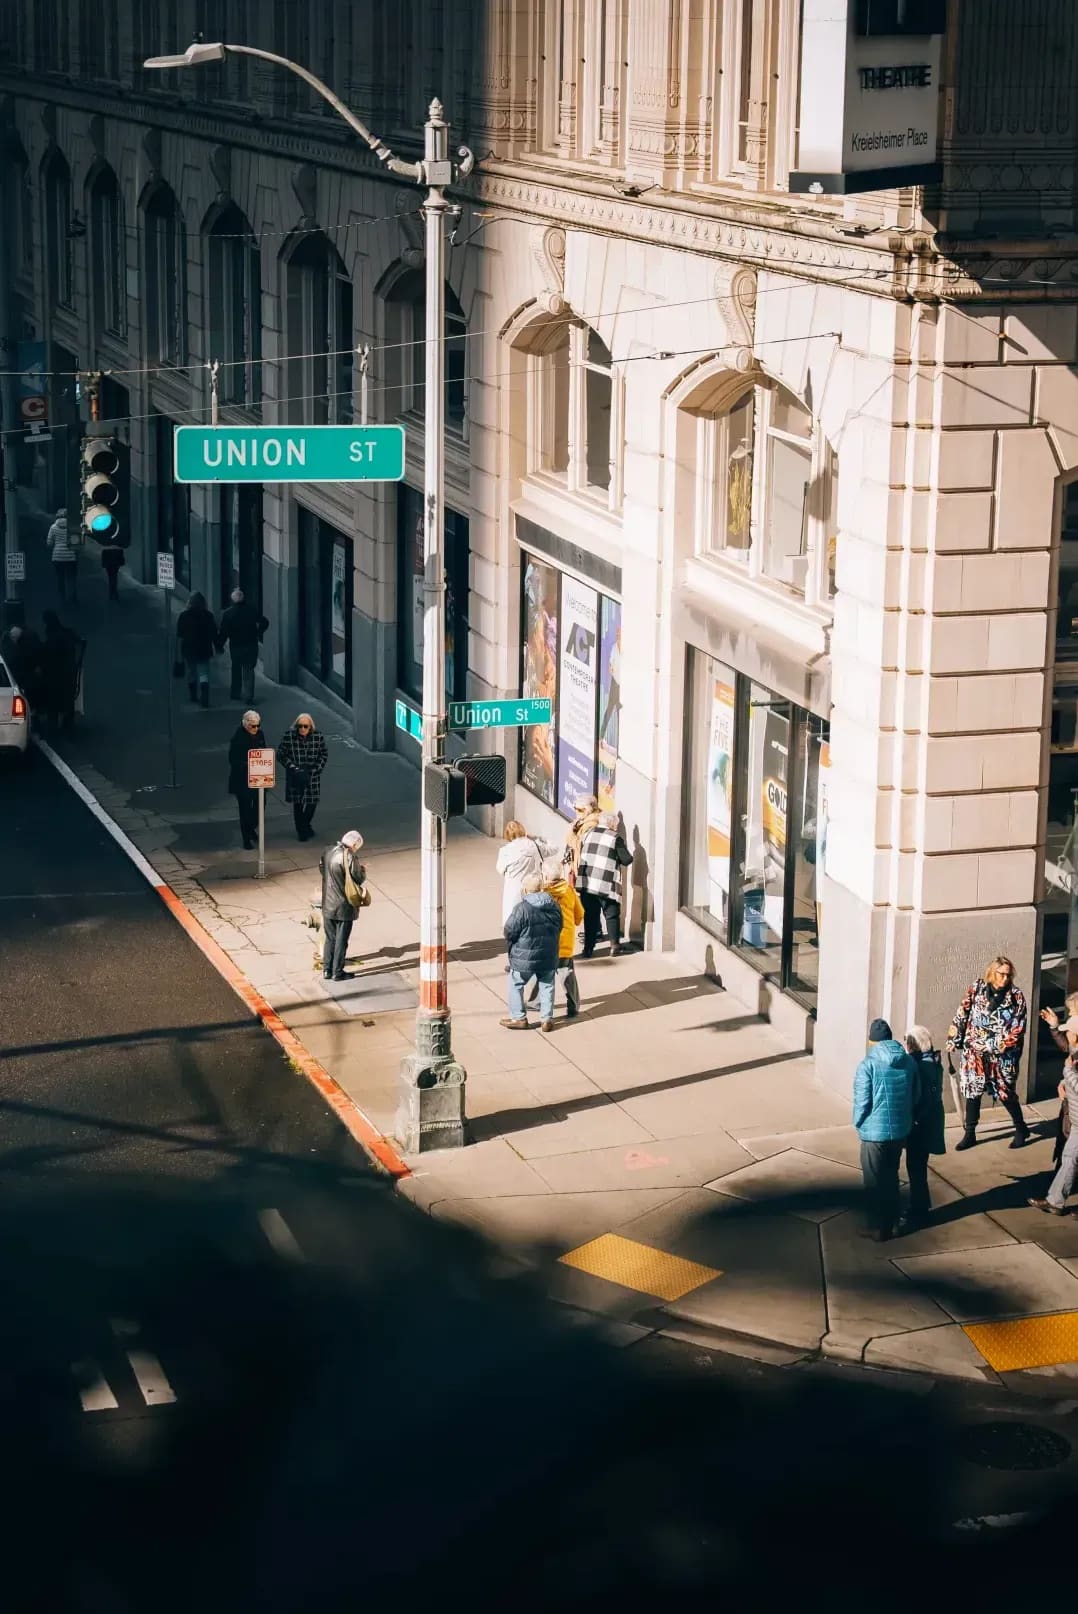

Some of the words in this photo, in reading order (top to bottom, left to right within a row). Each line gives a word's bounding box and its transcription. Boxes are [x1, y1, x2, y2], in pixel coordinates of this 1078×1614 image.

[859, 65, 931, 89] THEATRE
[907, 128, 928, 147] Place
[203, 438, 306, 467] UNION
[349, 441, 377, 462] ST
[566, 622, 595, 666] ACT
[454, 705, 502, 725] Union
[516, 708, 529, 721] St
[531, 700, 550, 711] 1500
